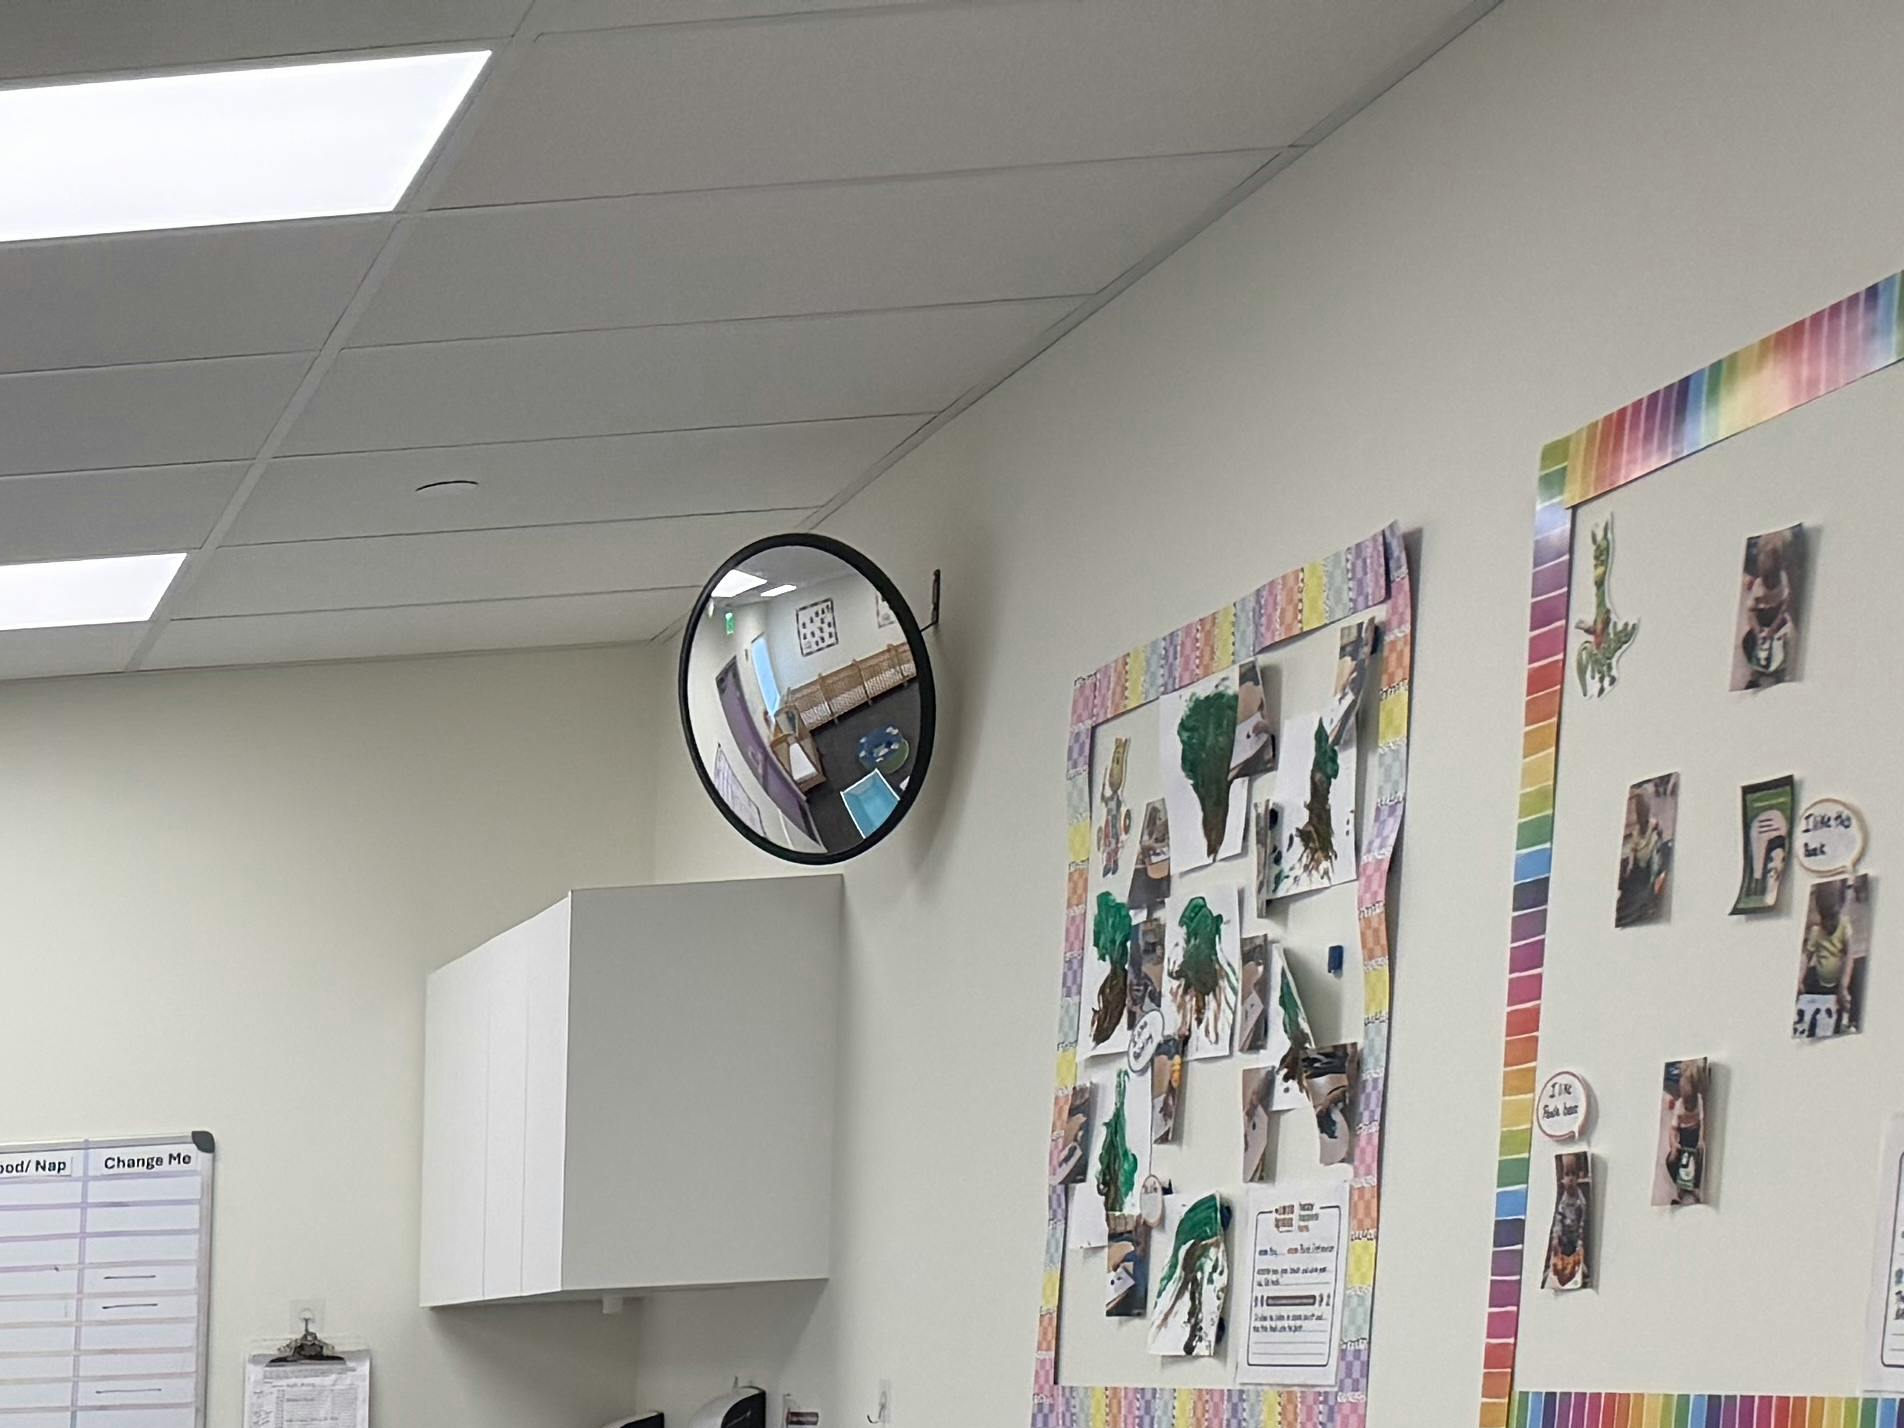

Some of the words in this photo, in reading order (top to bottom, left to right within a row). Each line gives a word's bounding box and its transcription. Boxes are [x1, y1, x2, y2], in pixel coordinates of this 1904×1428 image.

[35, 1159, 66, 1174] Nap
[104, 1156, 163, 1170] Change
[168, 1152, 191, 1165] Me
